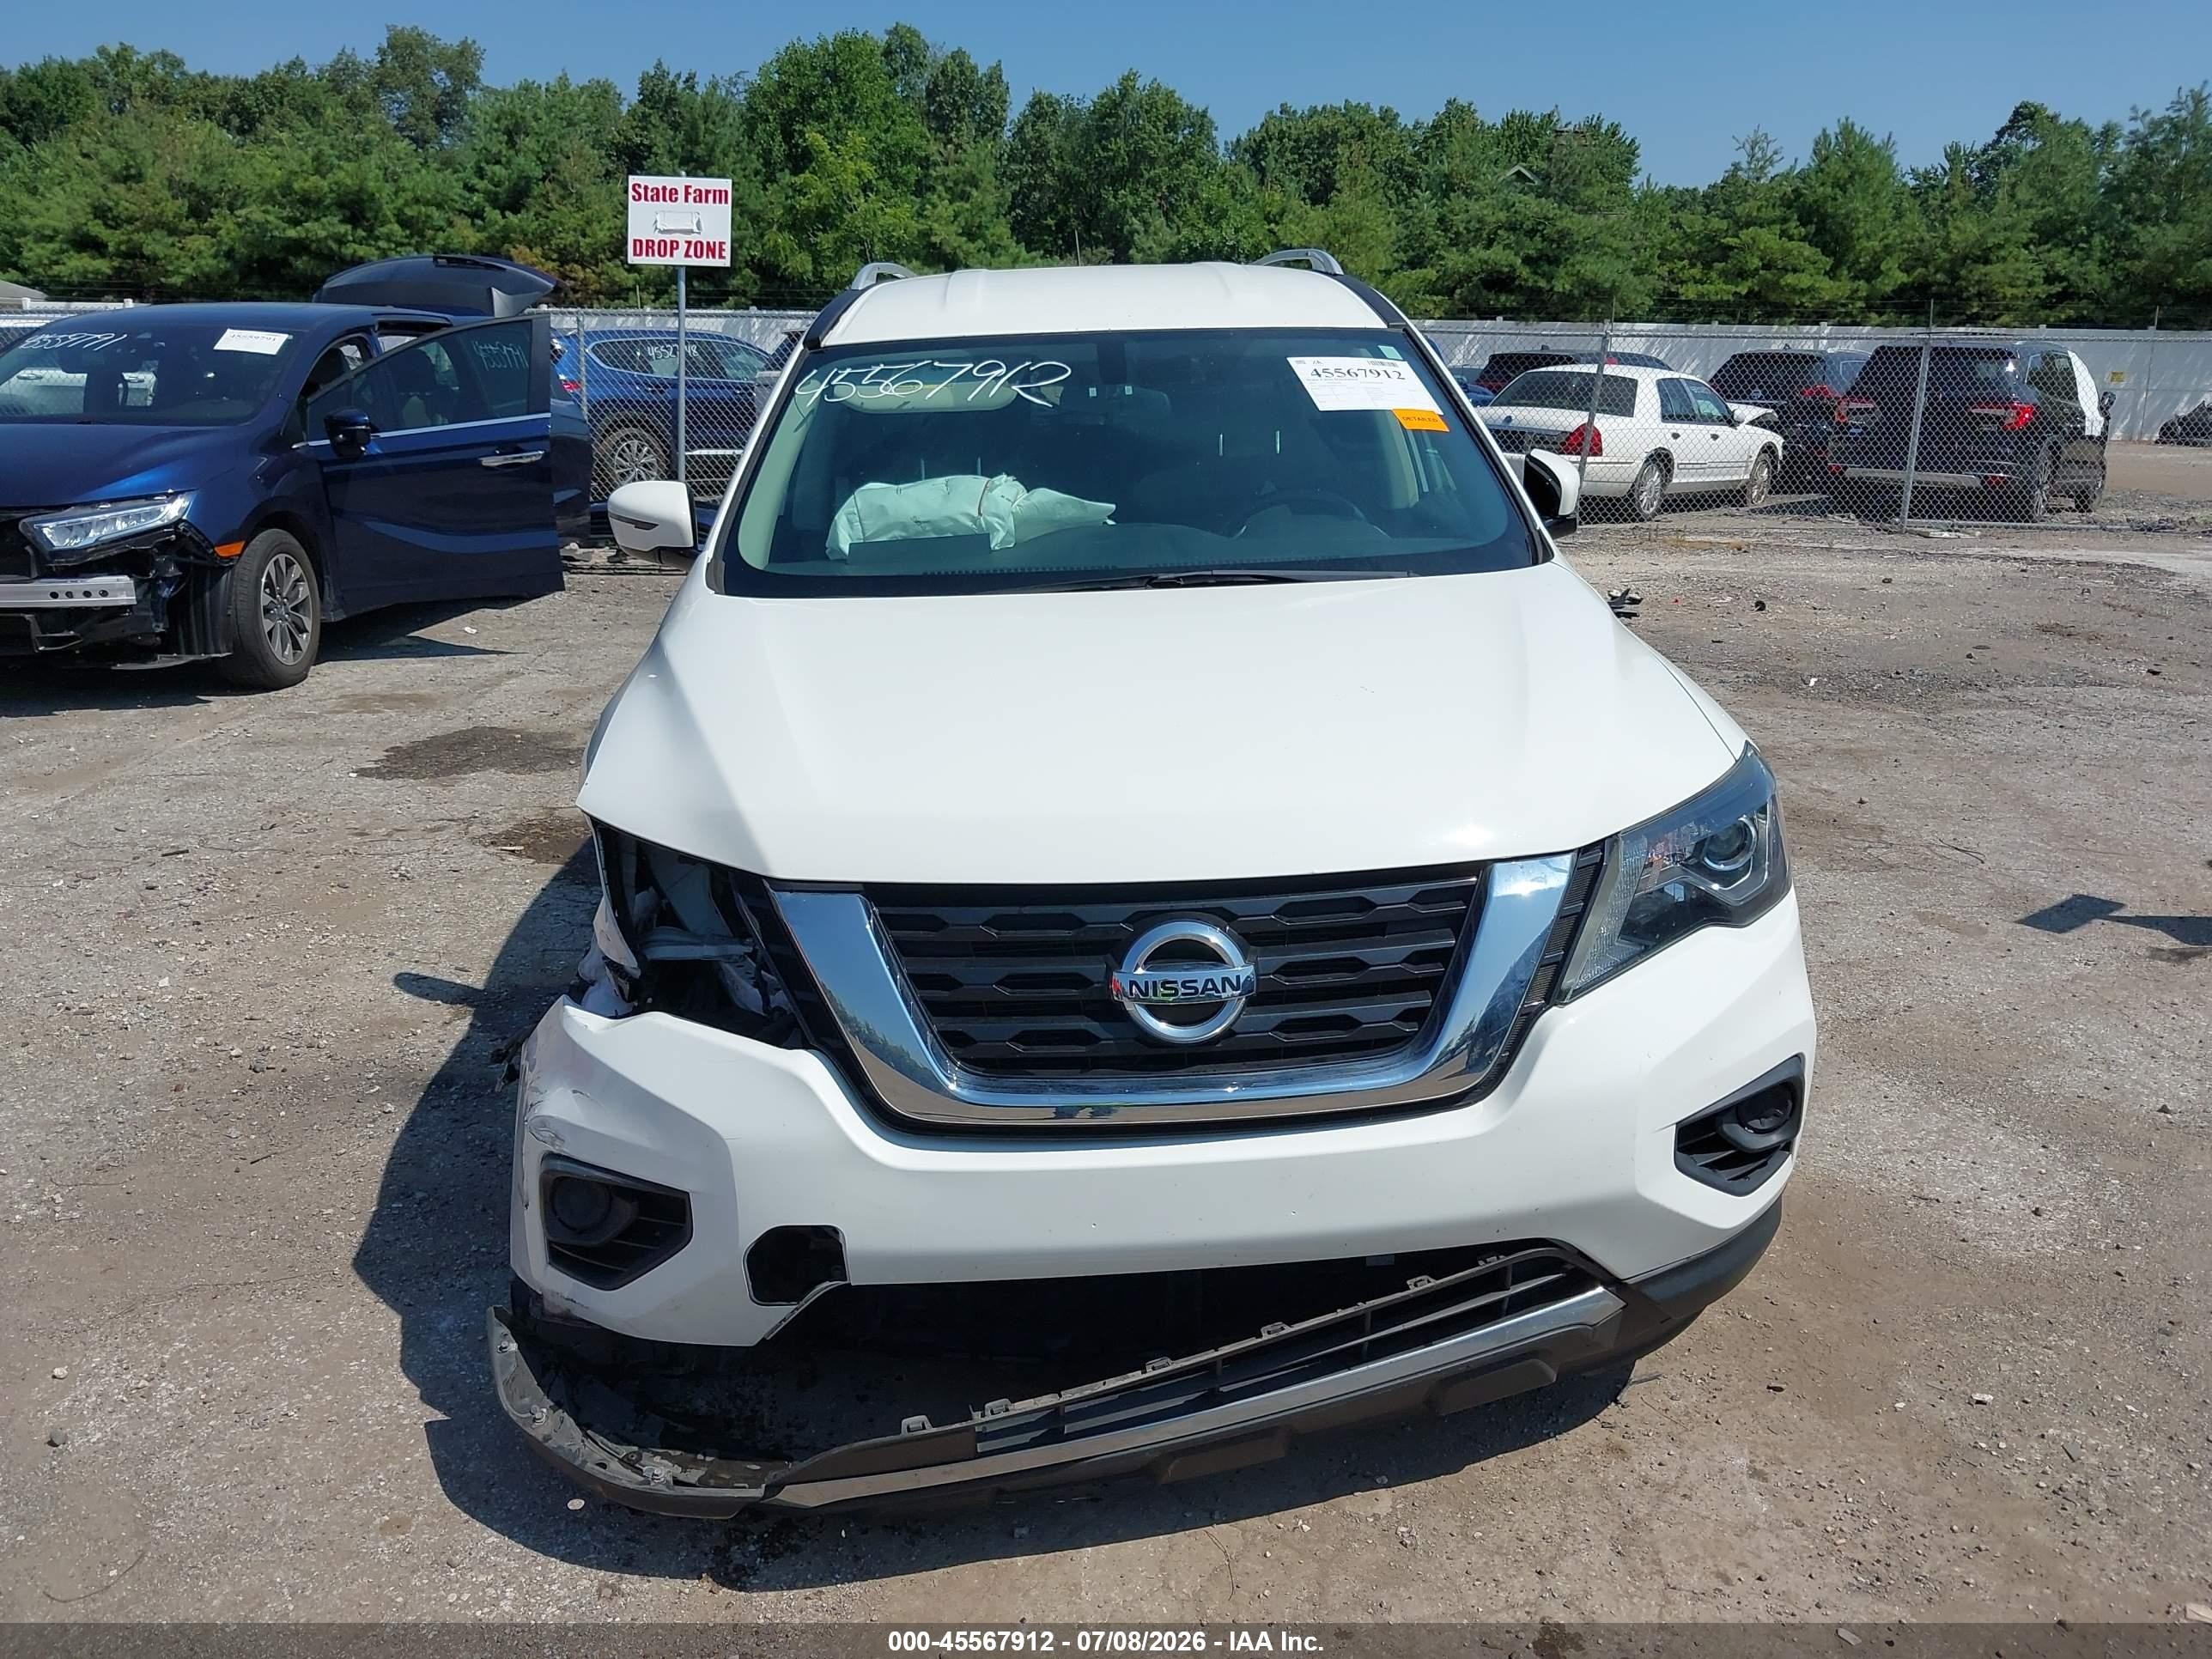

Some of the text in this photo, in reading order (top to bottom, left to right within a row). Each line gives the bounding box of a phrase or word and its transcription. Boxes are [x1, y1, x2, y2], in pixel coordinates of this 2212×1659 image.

[631, 183, 729, 204] State Farm
[632, 239, 726, 259] DROP ZONE
[793, 359, 1073, 408] 45567912
[1310, 367, 1406, 380] 45567912
[1128, 975, 1242, 999] NISSAN
